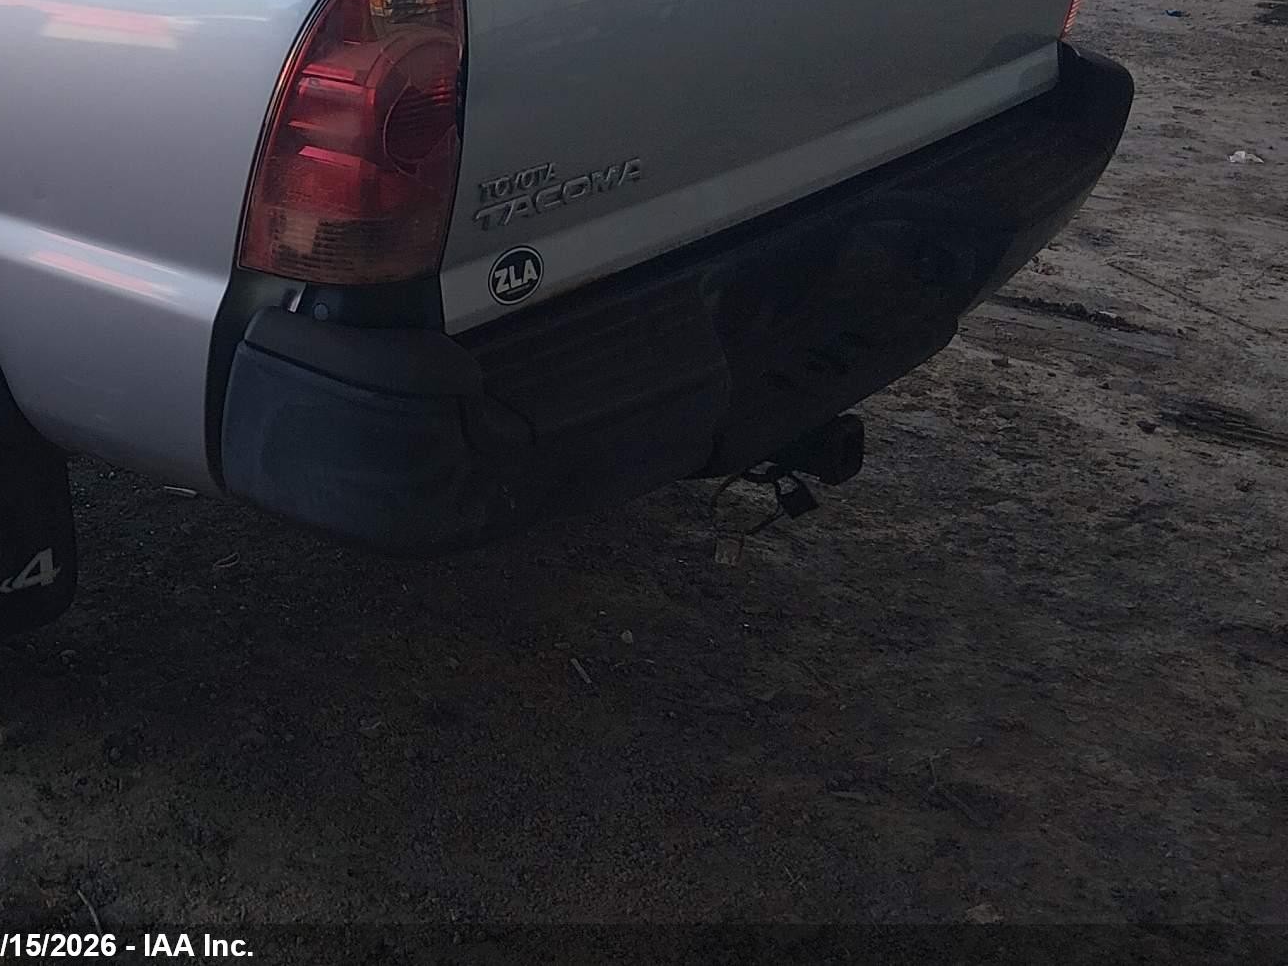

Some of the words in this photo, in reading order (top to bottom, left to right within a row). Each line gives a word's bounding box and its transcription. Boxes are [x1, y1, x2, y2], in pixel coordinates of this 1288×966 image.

[473, 157, 641, 231] TACOMA
[479, 162, 556, 200] TOYOTA
[494, 259, 538, 294] ZLA
